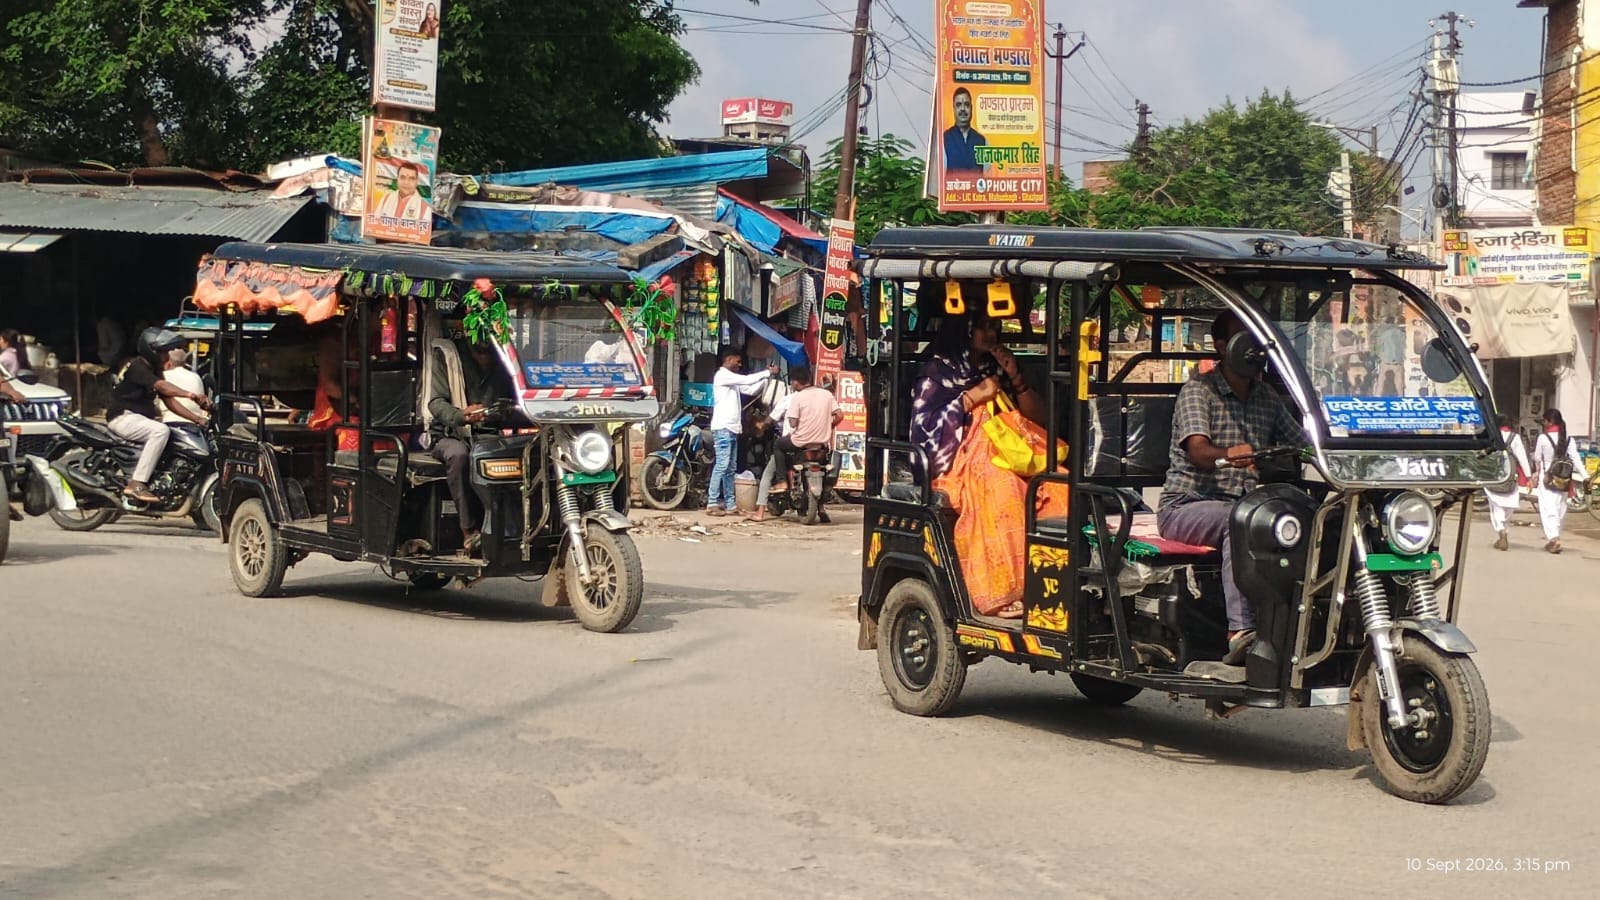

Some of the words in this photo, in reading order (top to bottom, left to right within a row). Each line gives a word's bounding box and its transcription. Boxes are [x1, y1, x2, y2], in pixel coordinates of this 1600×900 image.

[951, 40, 990, 65] विशाल
[993, 46, 1031, 66] भण्डारा
[979, 97, 1008, 112] भण्डारा
[974, 145, 1020, 170] राजकुमार
[1020, 142, 1040, 164] सिंह
[987, 179, 1018, 192] PHONE
[1021, 179, 1042, 192] CITY
[831, 231, 853, 252] विशाल
[995, 234, 1027, 247] YATRI
[1474, 235, 1507, 248] रजा
[1510, 231, 1556, 249] ट्रेडिंग
[577, 403, 611, 415] Yatri
[1327, 397, 1387, 412] एवरेस्ट
[1390, 397, 1430, 411] ऑटो
[1432, 398, 1476, 411] सेल्स
[1397, 457, 1446, 476] Yatri
[960, 635, 994, 650] SPORTS
